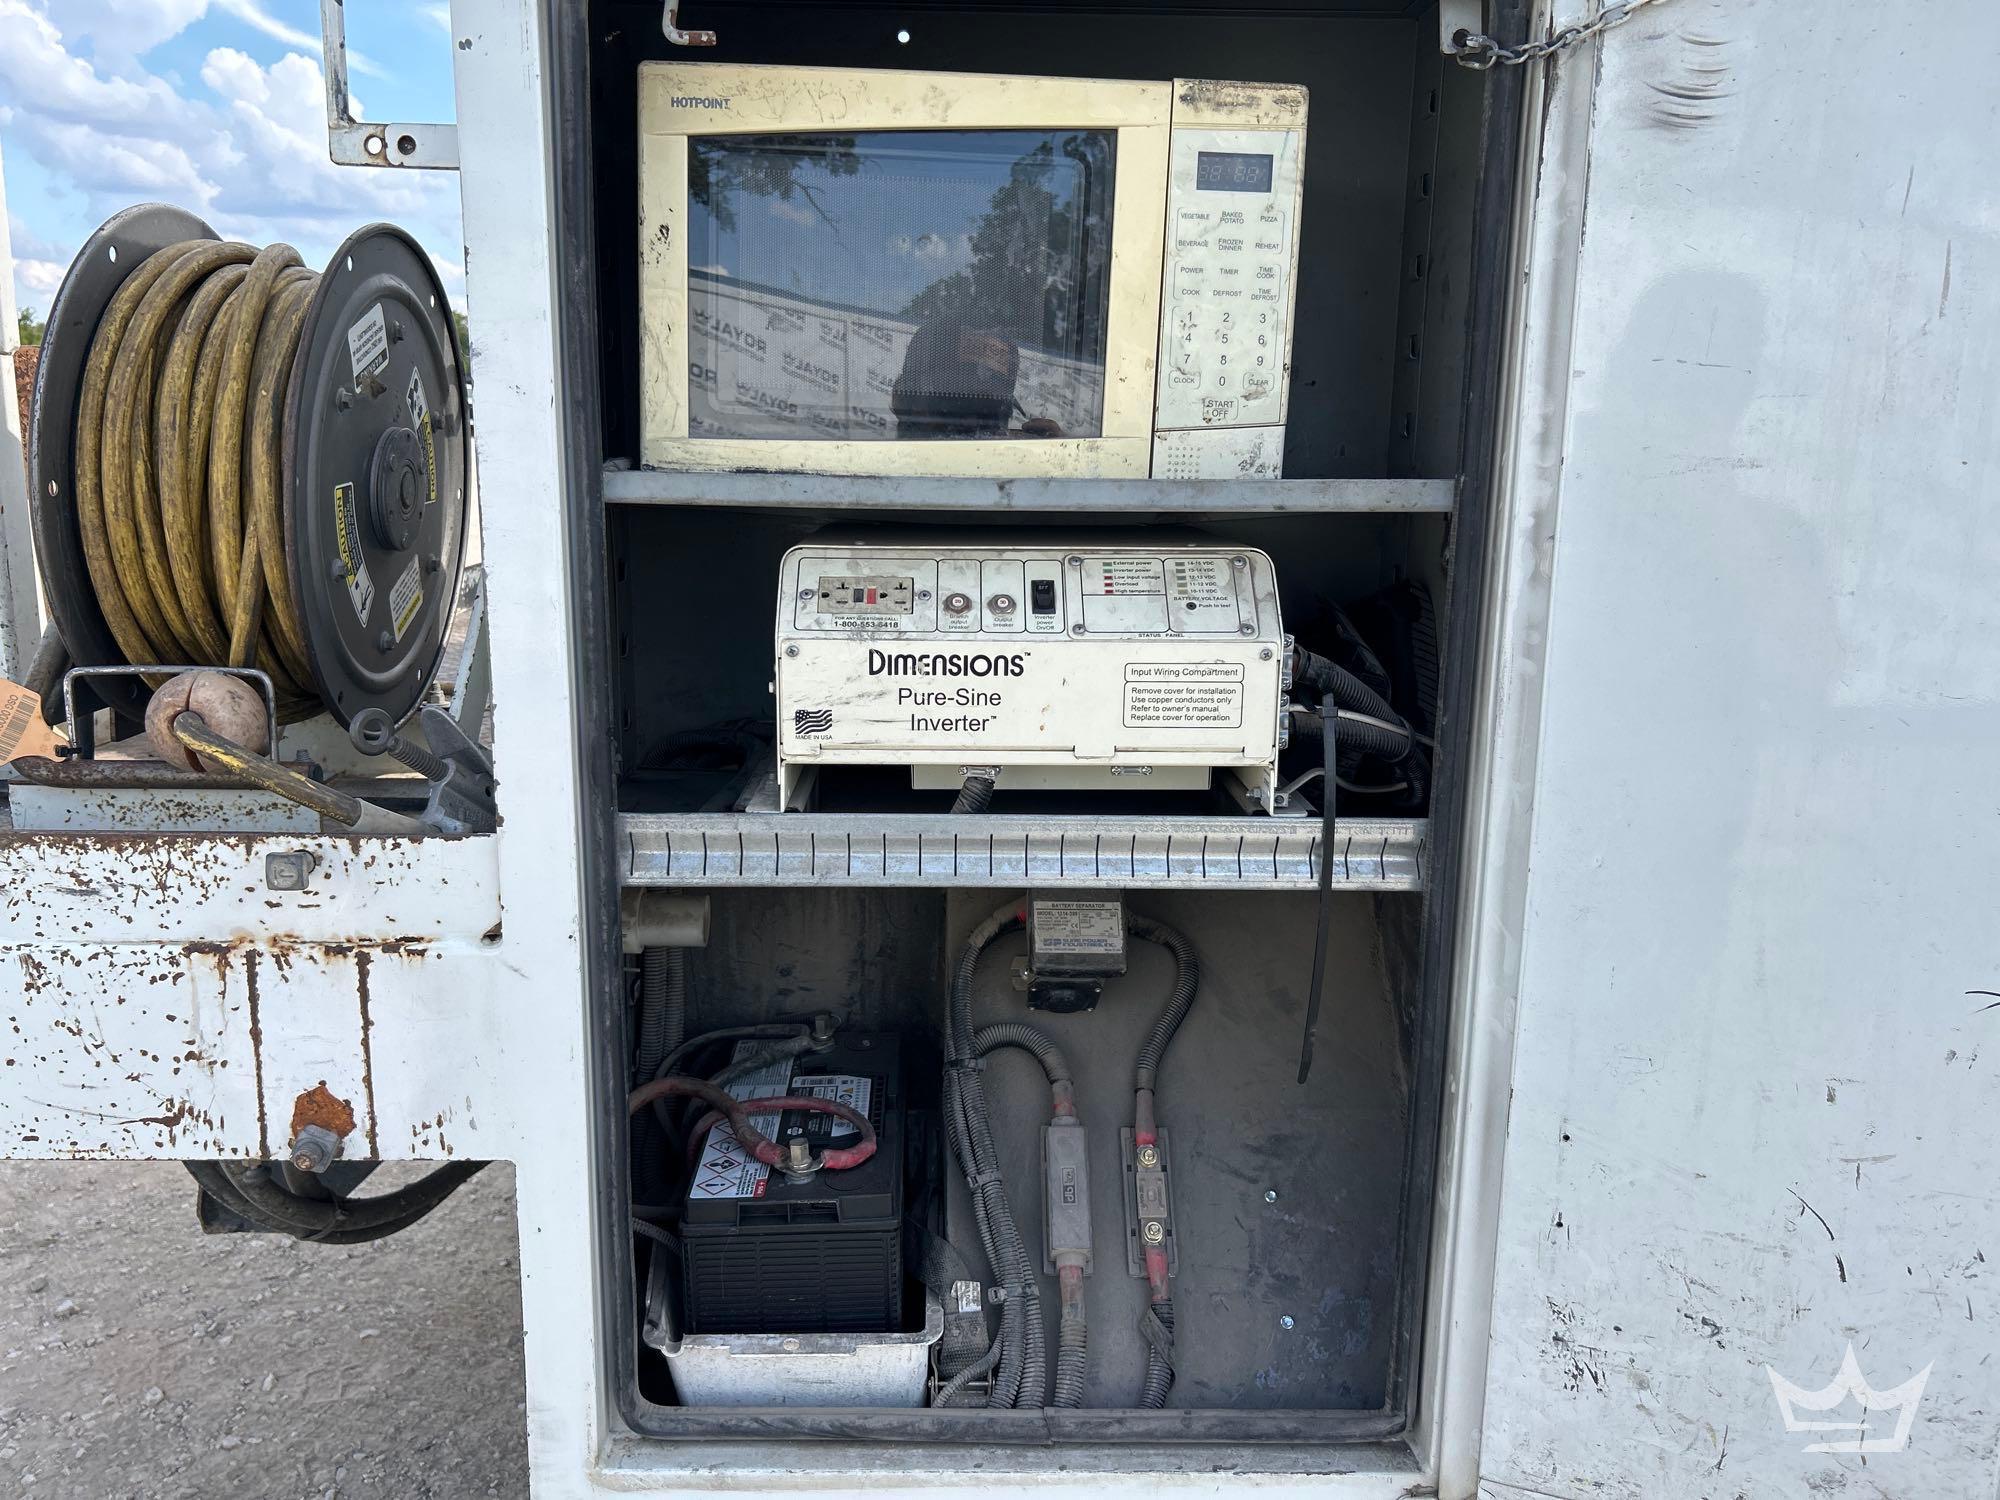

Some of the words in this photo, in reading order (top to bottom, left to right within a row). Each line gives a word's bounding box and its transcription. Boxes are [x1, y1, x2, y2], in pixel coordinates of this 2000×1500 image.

[670, 96, 731, 110] HOTPOINT
[1260, 215, 1278, 223] PIZZA
[1178, 239, 1209, 248] BEVERAGE
[1218, 238, 1243, 246] FROZEN
[1255, 242, 1279, 250] REHEAT
[1180, 266, 1204, 274] POWER
[1181, 288, 1200, 296] COOK
[1213, 289, 1242, 297] DEFROST
[1250, 293, 1278, 301] DEFROST
[1187, 311, 1193, 322] 1
[1222, 312, 1230, 324] 2
[1258, 313, 1267, 325] 3
[1184, 333, 1192, 343] 4
[1221, 334, 1229, 345] 5
[1257, 334, 1266, 346] 6
[1183, 354, 1192, 365] 7
[1219, 355, 1228, 366] 8
[1255, 356, 1264, 367] 9
[1173, 377, 1196, 385] CLOCK
[1218, 376, 1227, 388] 0
[1247, 379, 1269, 387] CLEAR
[1207, 400, 1235, 409] START
[1211, 409, 1230, 418] OFF
[336, 496, 351, 566] CAUTION
[1131, 668, 1152, 677] Input
[1154, 668, 1180, 677] Wiring
[1182, 668, 1238, 677] Compartment
[898, 687, 1001, 706] Pure-Sine
[1216, 696, 1232, 704] only
[1130, 714, 1160, 722] Replace
[1196, 714, 1230, 722] operation
